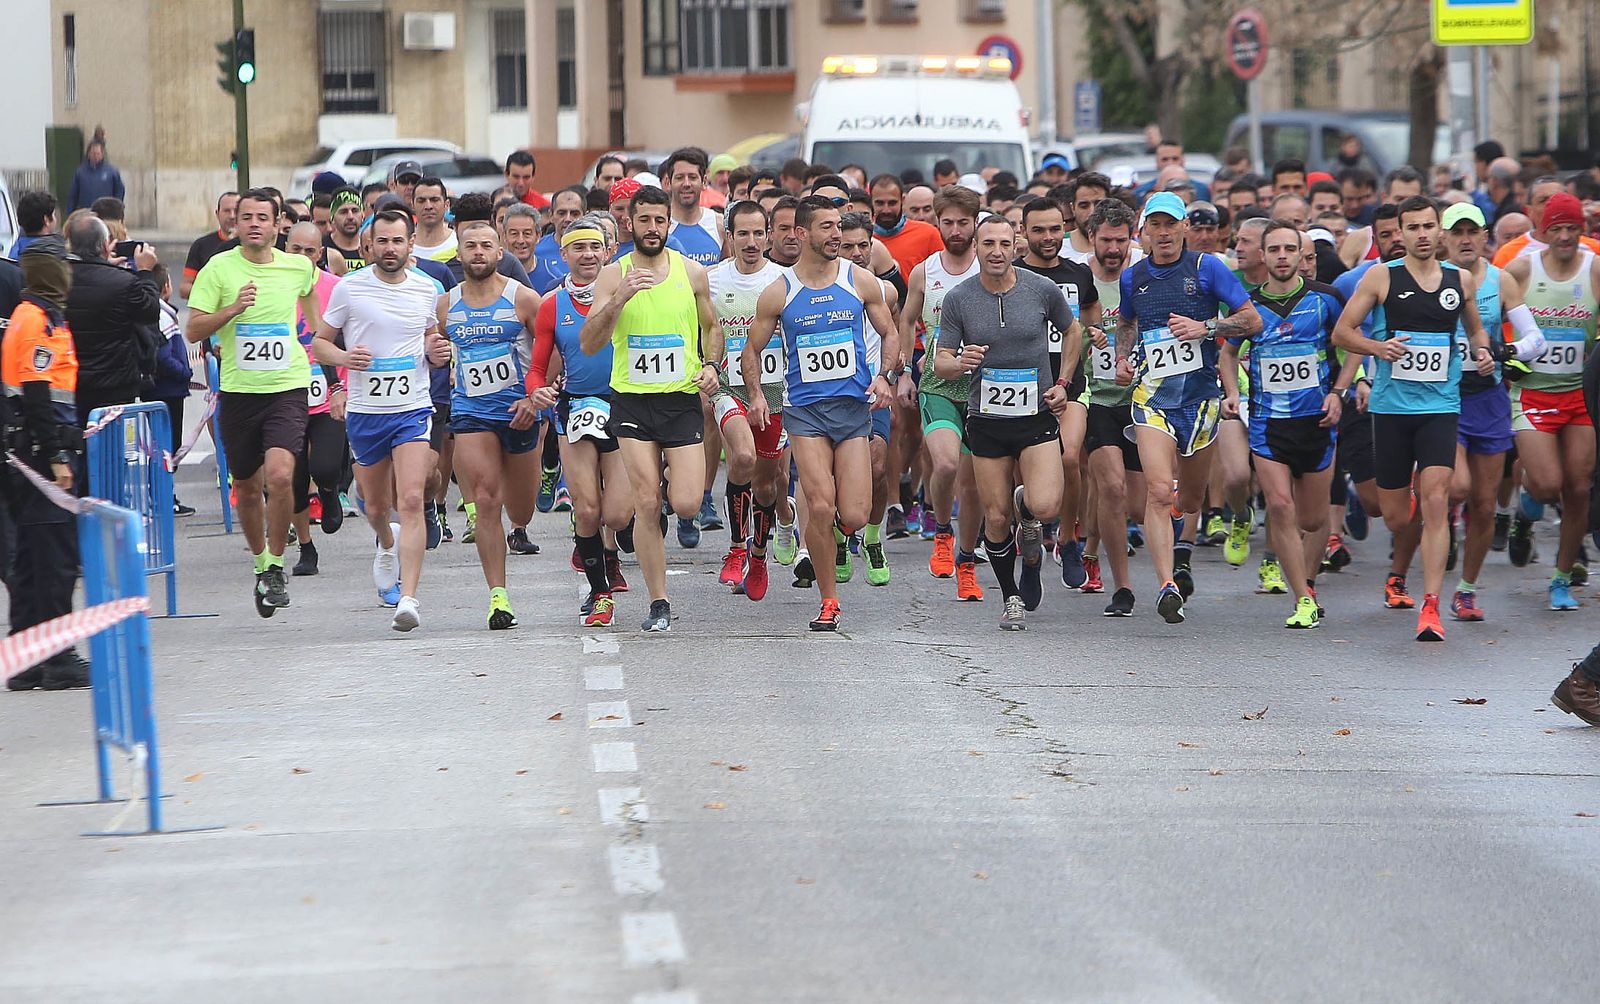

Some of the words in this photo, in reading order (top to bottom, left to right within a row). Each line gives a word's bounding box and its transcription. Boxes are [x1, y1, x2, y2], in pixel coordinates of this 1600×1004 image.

[243, 341, 284, 361] 240
[807, 348, 849, 373] 300
[1152, 341, 1195, 369] 213
[1401, 351, 1442, 371] 398
[469, 361, 510, 387] 310
[635, 352, 675, 374] 411
[1269, 361, 1310, 383] 296
[368, 375, 410, 397] 273
[988, 386, 1028, 407] 221
[571, 411, 607, 432] 299
